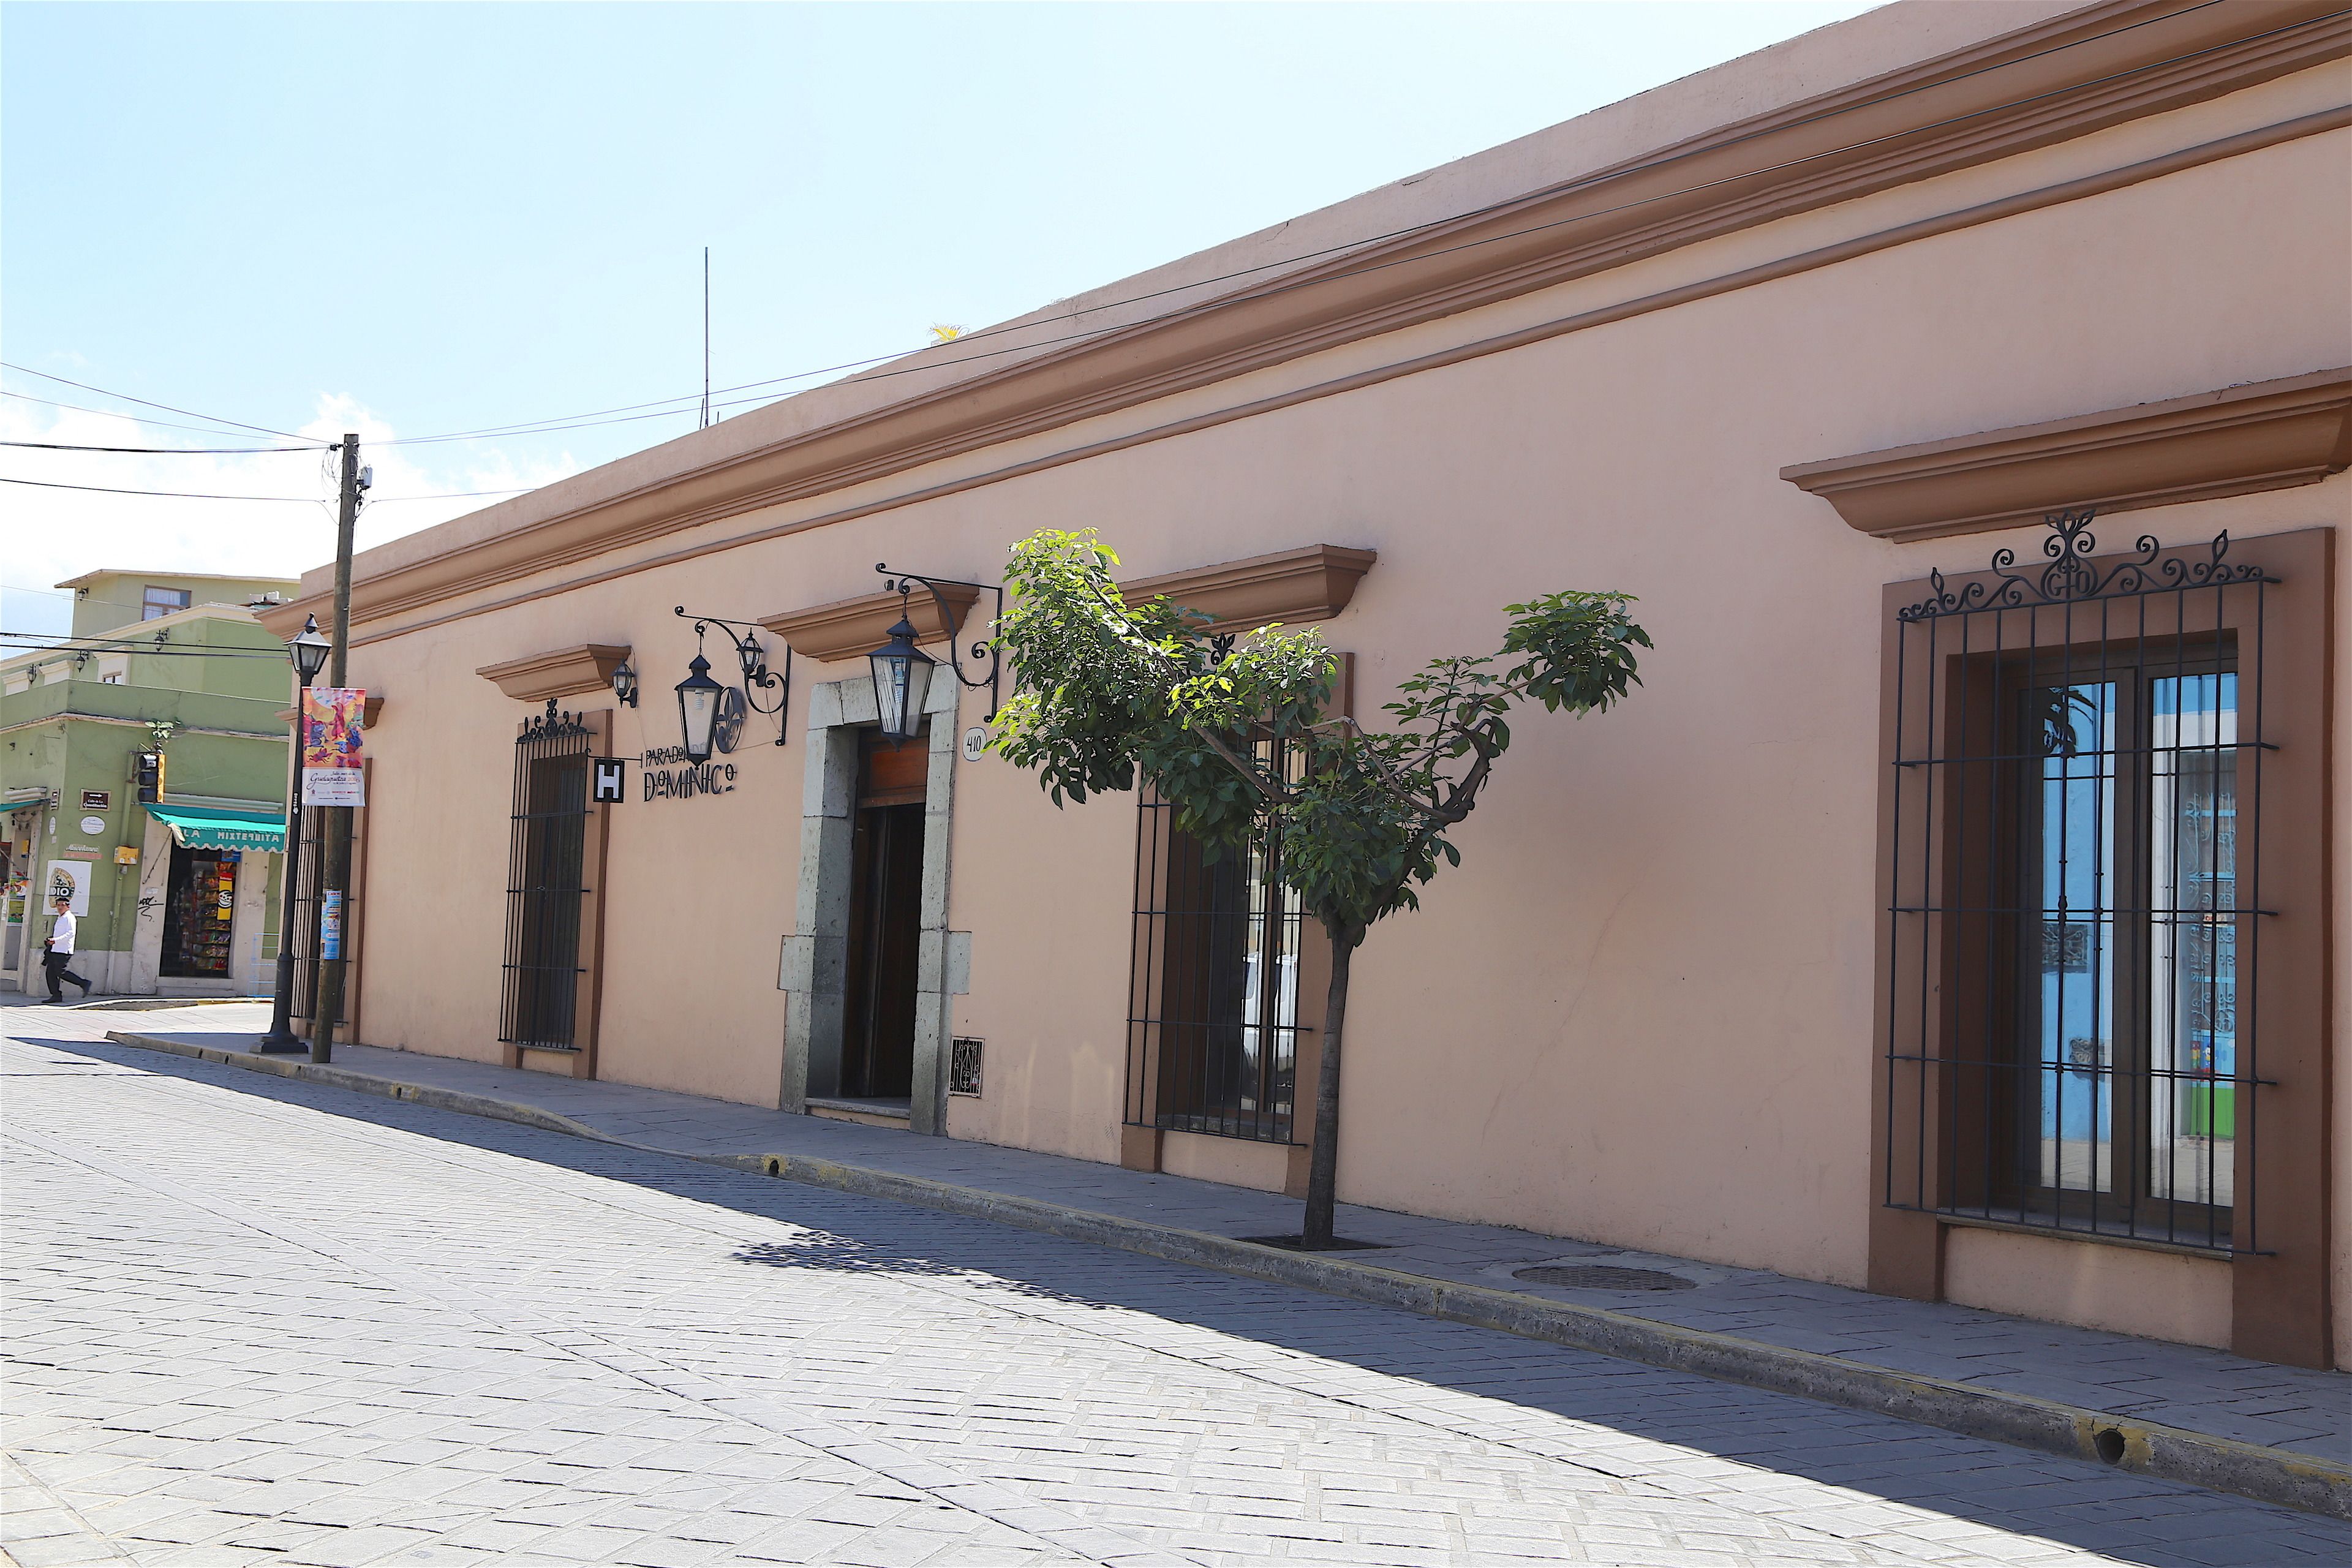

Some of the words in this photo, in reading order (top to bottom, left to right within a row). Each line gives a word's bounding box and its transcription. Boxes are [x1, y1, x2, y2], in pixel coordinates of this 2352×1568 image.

[967, 735, 982, 753] 410
[597, 764, 620, 799] H
[644, 763, 737, 802] DOMINICO
[184, 829, 200, 839] LA
[217, 831, 280, 842] MIXTEQUITA
